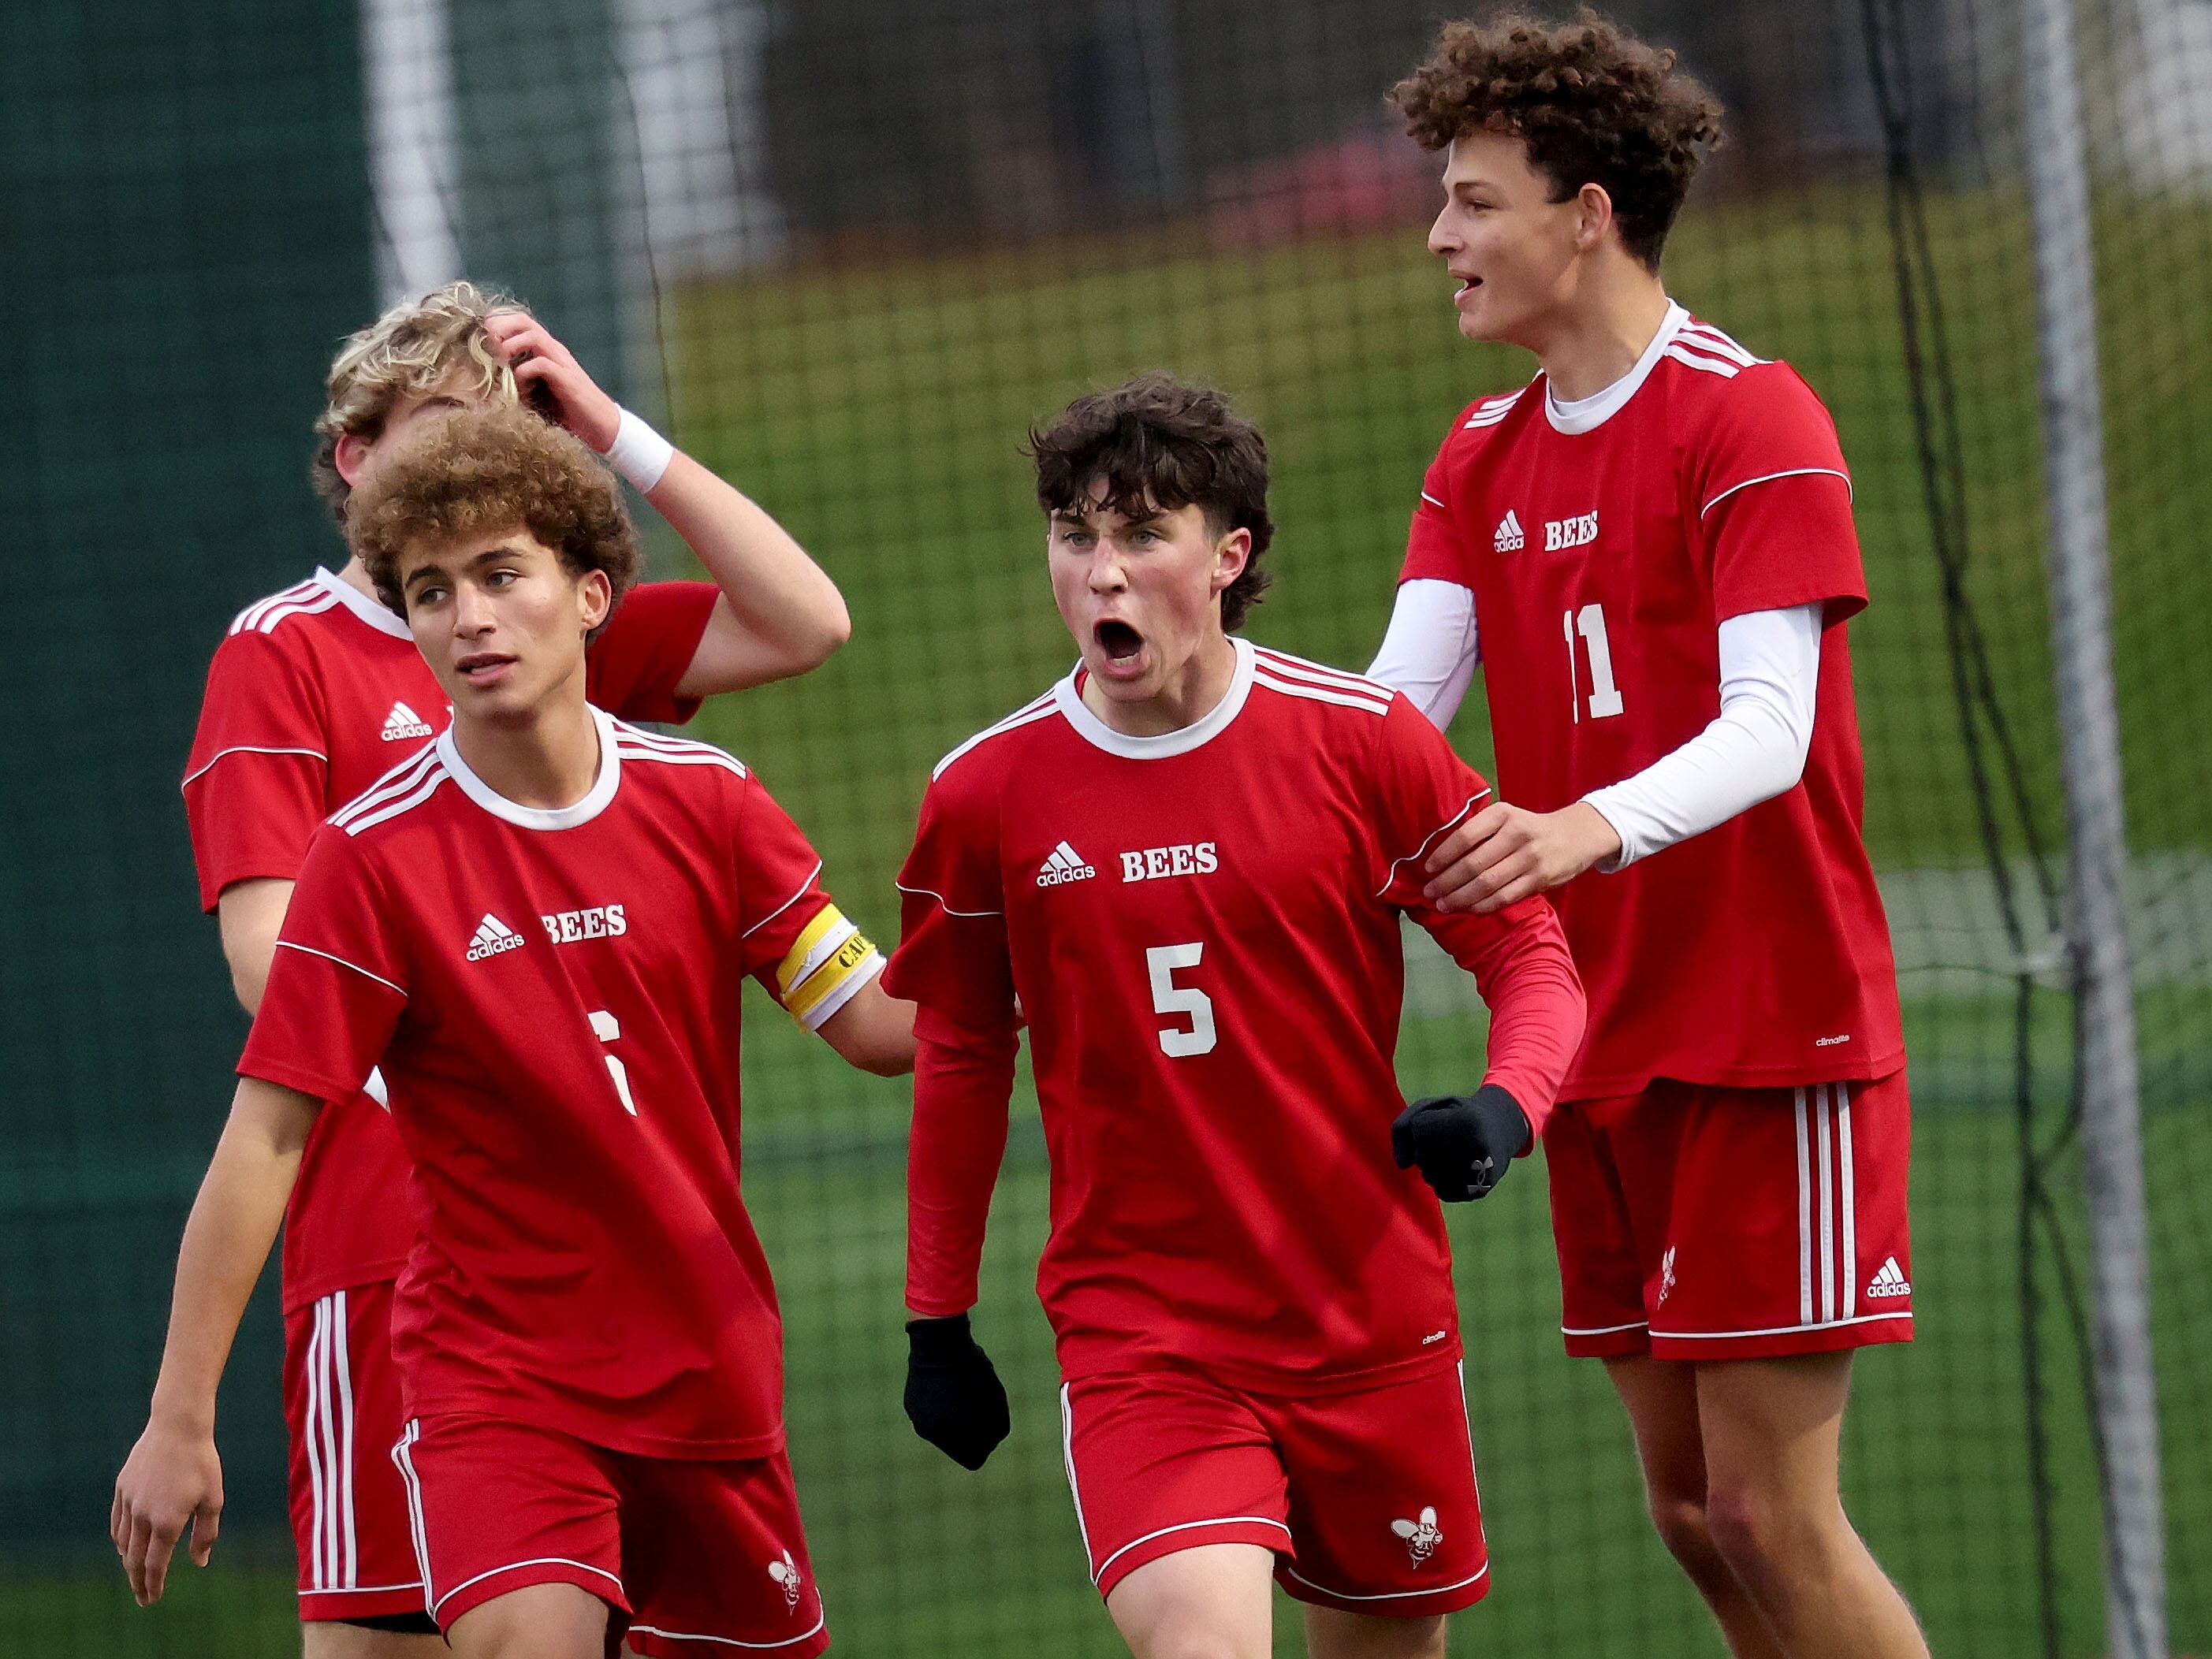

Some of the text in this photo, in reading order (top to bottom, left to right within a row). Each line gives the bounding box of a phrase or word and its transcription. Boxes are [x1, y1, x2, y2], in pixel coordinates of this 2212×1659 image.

[1495, 535, 1525, 553] adida
[1545, 510, 1598, 551] BEES
[381, 723, 433, 741] adidas
[1037, 865, 1096, 887] adidas
[1120, 843, 1218, 883] BEES
[541, 904, 627, 944] BEES
[466, 933, 525, 962] adidas
[1146, 942, 1216, 1058] 5
[1867, 1281, 1912, 1297] adidas
